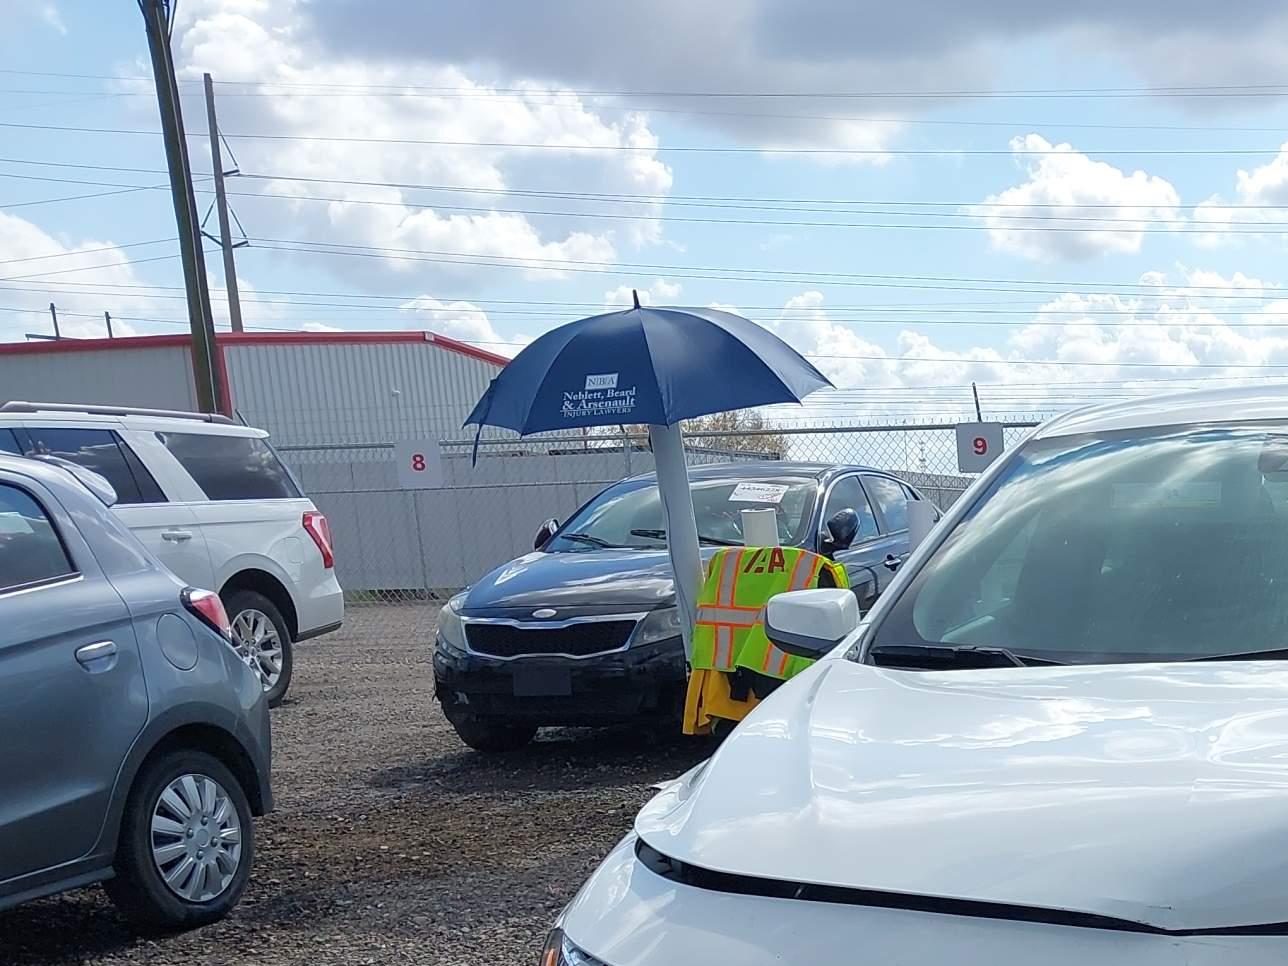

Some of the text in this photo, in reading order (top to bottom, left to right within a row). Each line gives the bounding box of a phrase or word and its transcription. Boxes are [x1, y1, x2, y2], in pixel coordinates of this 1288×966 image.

[563, 386, 636, 401] Neblett, Beard
[563, 396, 636, 410] & Arsenault
[564, 407, 632, 418] INJURY LAWYERS
[973, 437, 988, 455] 9
[411, 454, 426, 471] 8
